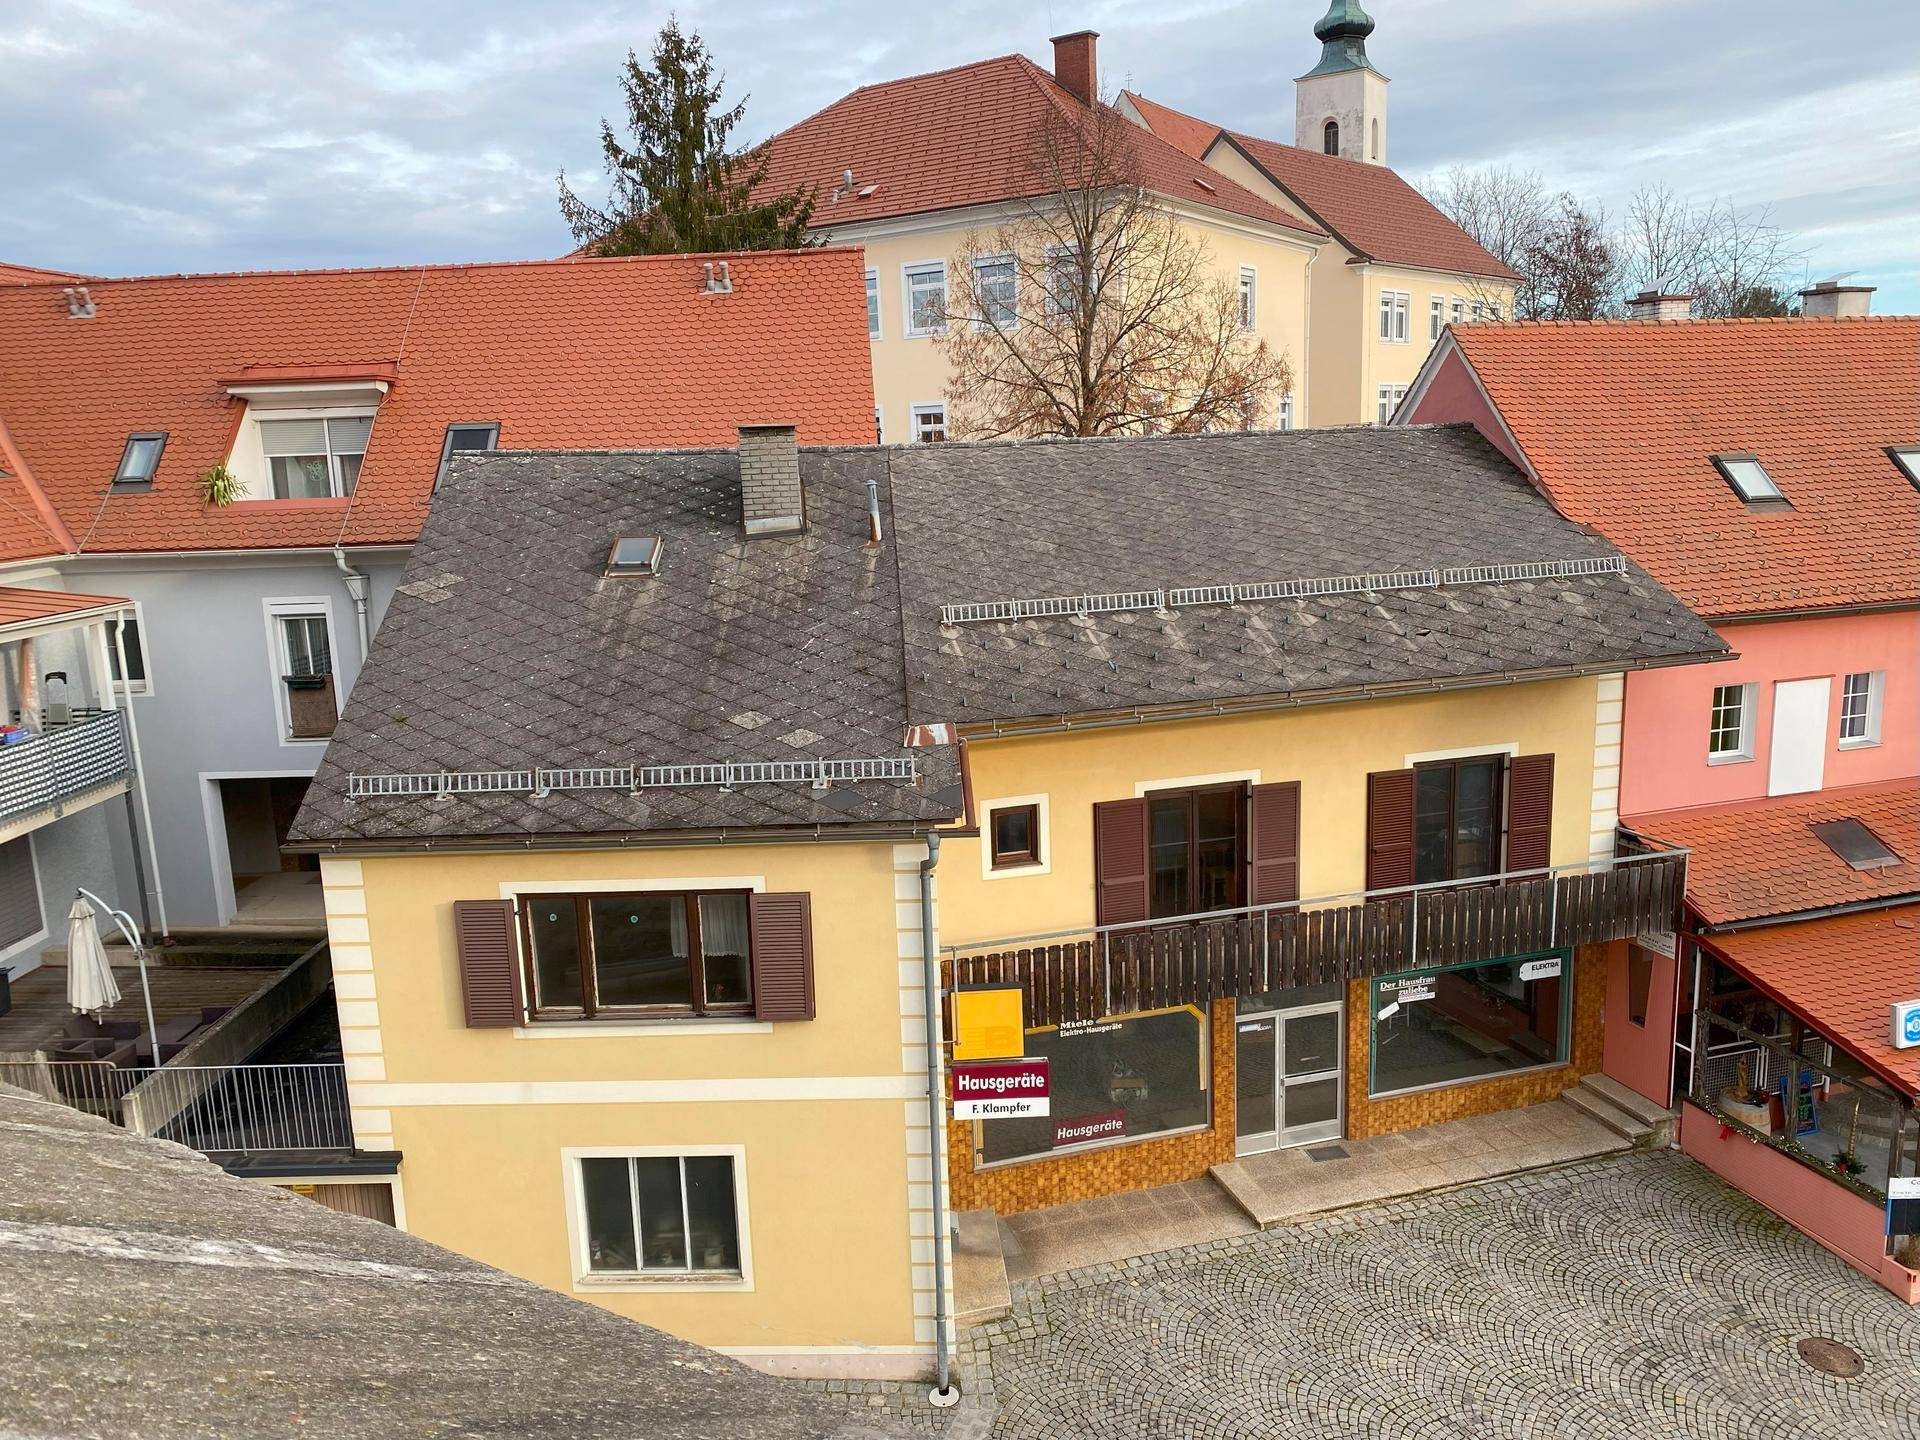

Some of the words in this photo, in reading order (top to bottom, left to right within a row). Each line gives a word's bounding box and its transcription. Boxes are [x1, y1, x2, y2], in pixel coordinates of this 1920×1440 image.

[1531, 961, 1559, 971] ELEKTRA
[1380, 981, 1396, 990] Der
[1398, 976, 1436, 987] Hausfrau
[1398, 985, 1428, 996] zuliebe
[1060, 1020, 1094, 1029] Miele
[1060, 1023, 1123, 1037] Elektro-Hausgeräte
[958, 1072, 1045, 1093] Hausgeräte
[972, 1104, 980, 1113] F.
[982, 1102, 1031, 1114] Klampfer
[1057, 1120, 1123, 1139] Hausgeräte
